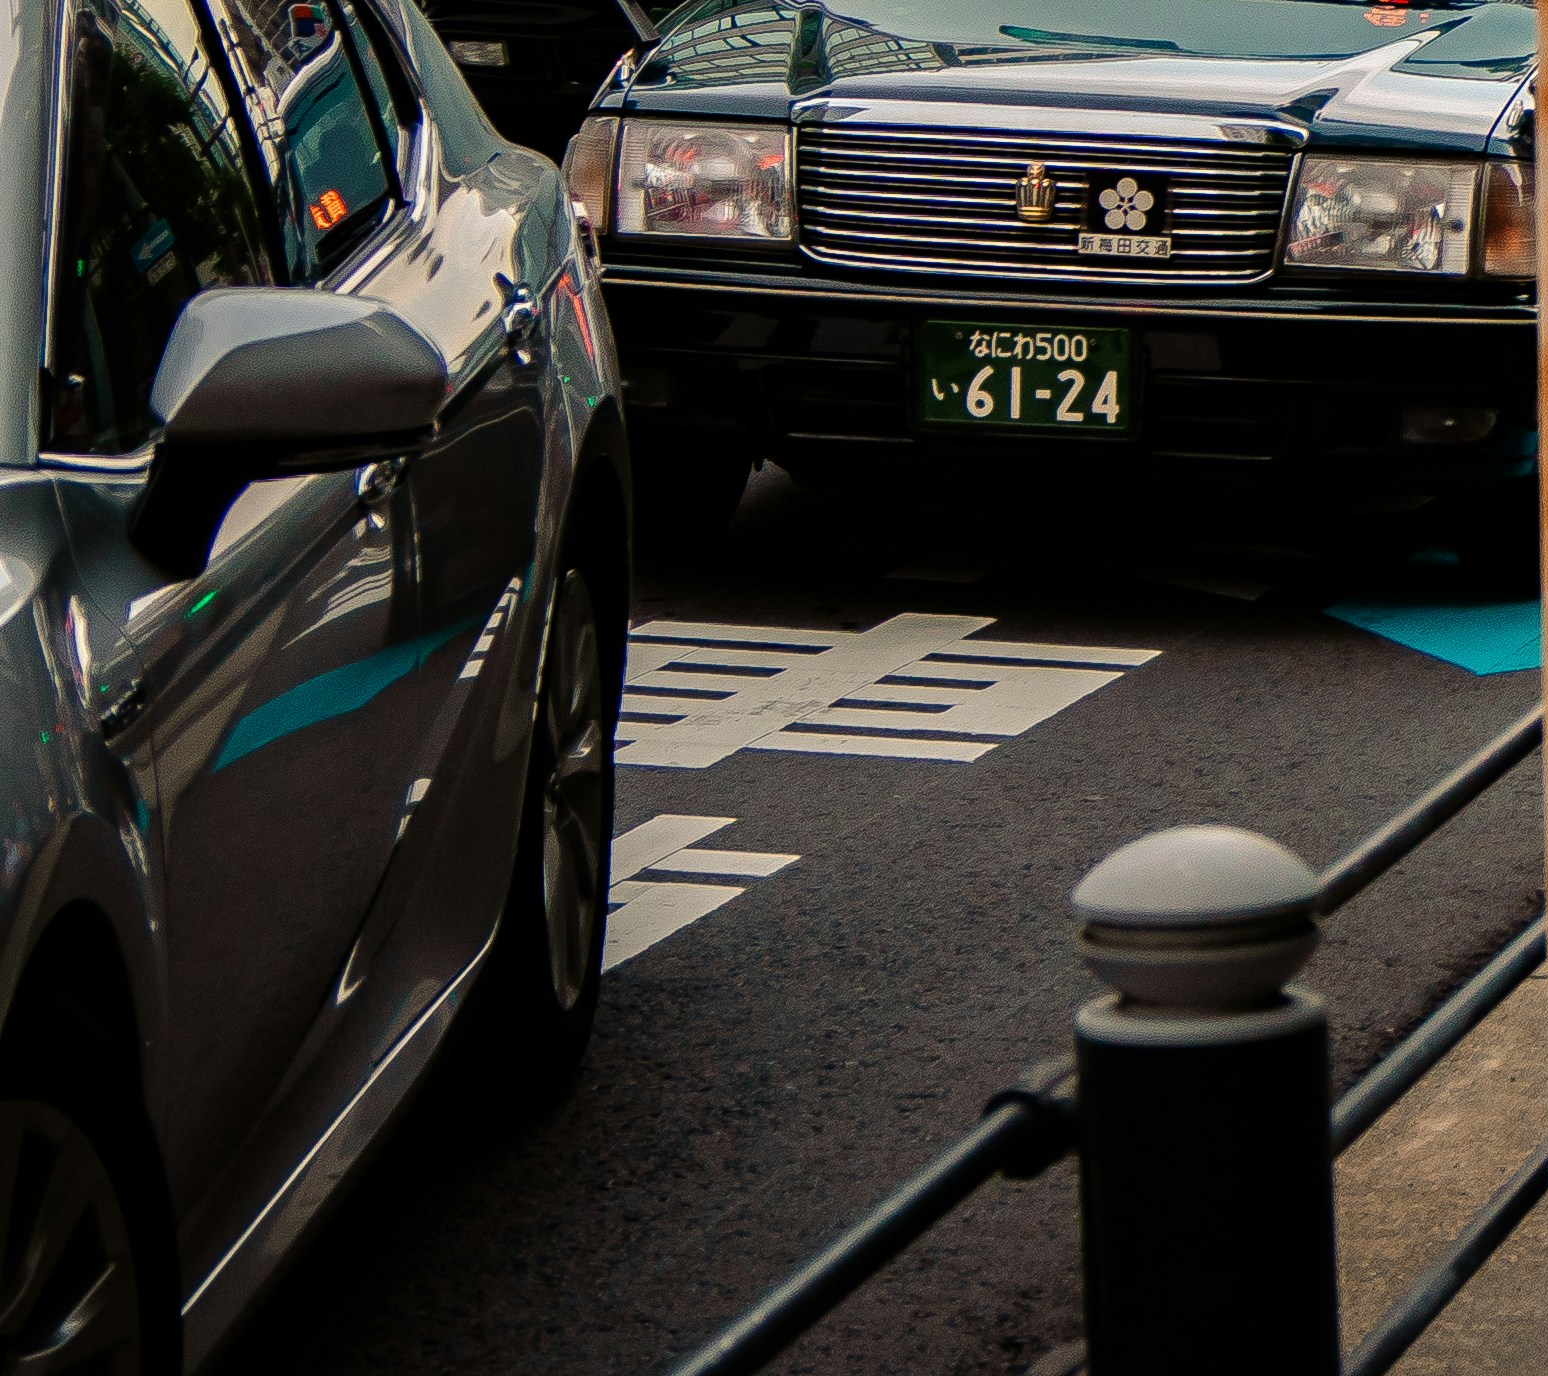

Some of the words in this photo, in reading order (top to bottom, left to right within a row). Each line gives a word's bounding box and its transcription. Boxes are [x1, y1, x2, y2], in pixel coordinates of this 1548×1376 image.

[1080, 235, 1170, 257] 新梅田交通
[969, 329, 1089, 363] なにわ500
[931, 377, 959, 402] い
[966, 365, 1121, 424] 61-24
